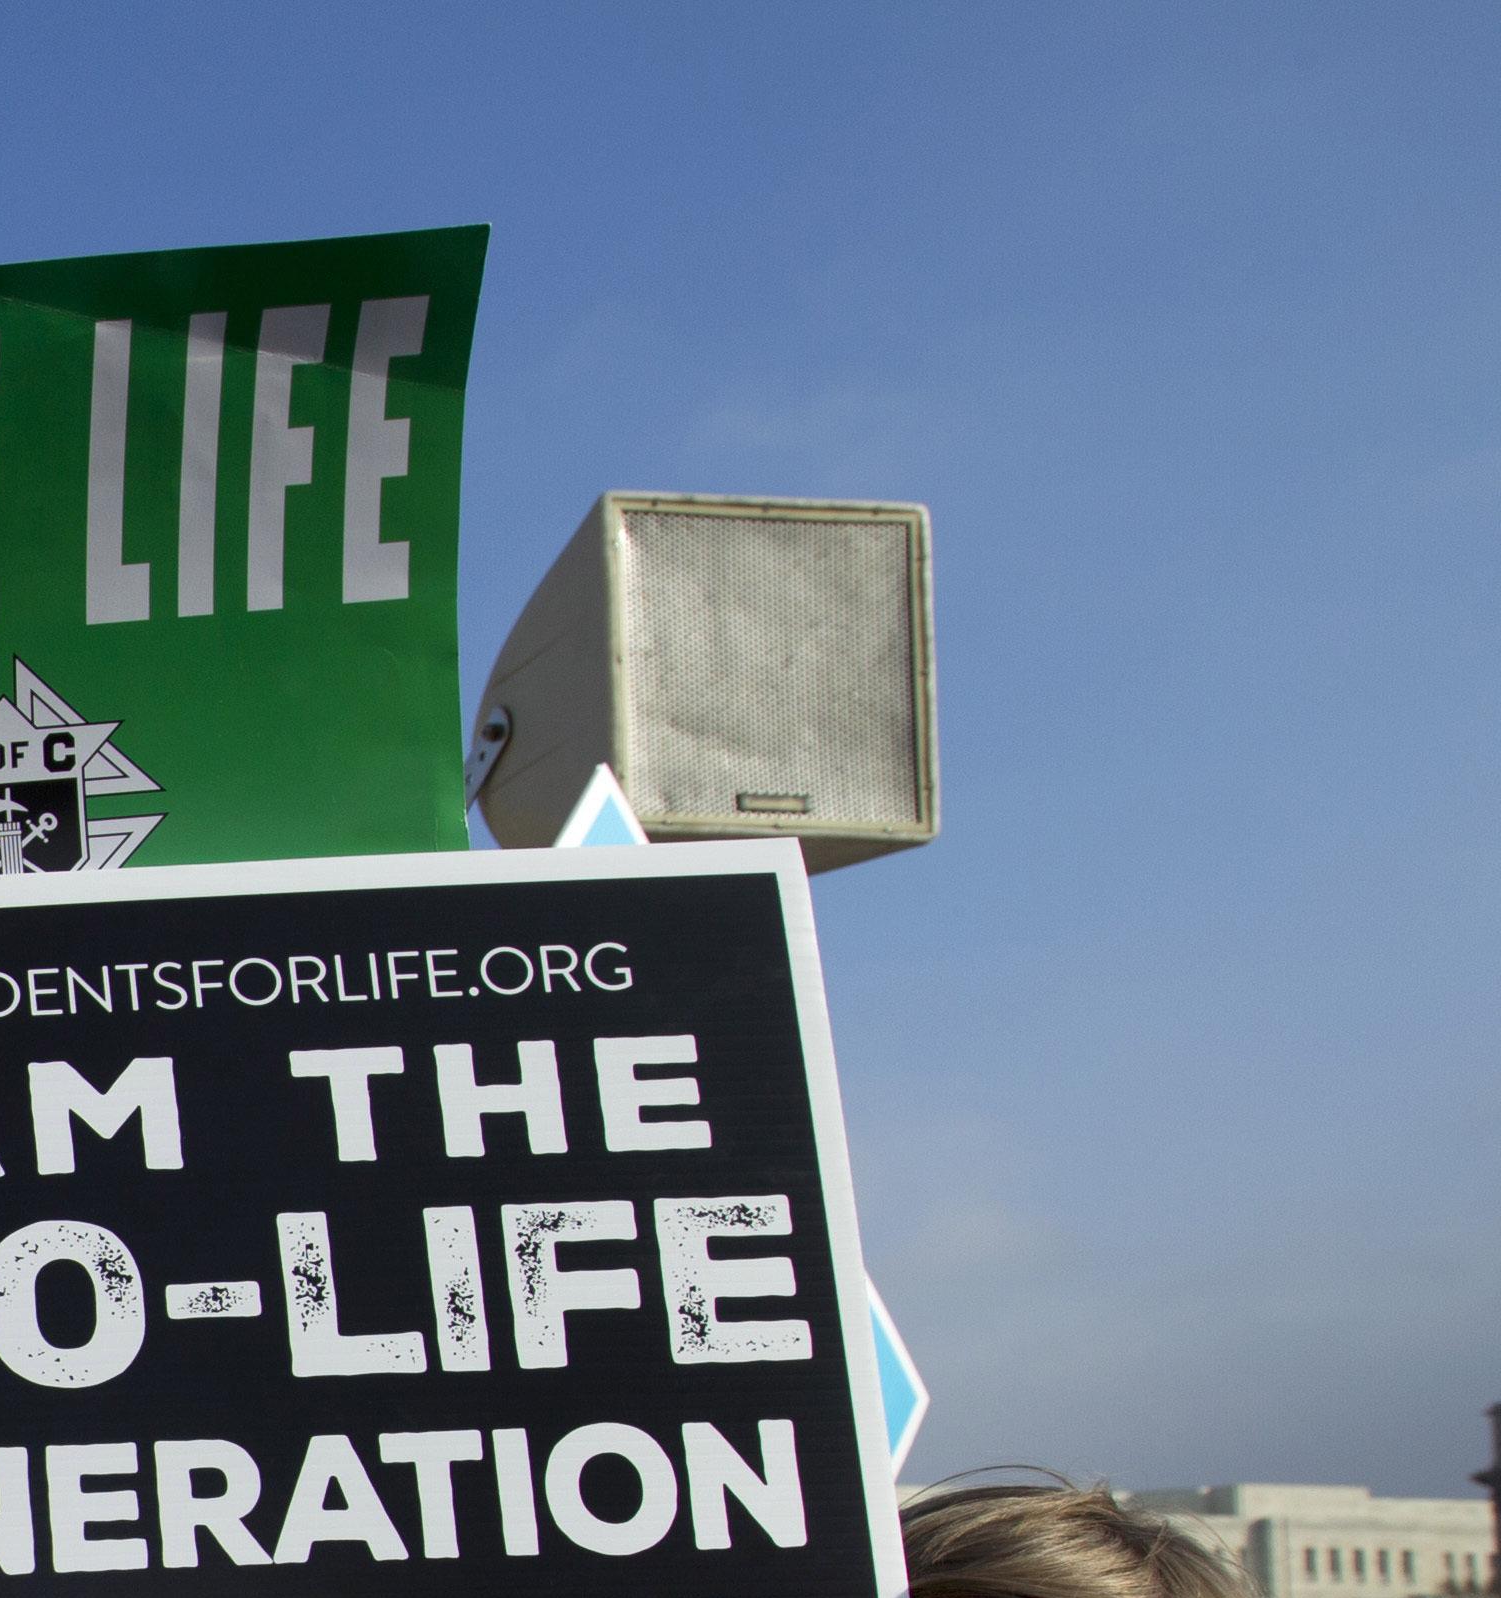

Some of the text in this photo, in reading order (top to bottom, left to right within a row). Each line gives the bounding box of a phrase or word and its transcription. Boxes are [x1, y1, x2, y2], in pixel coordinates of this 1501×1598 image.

[86, 295, 430, 626] LIFE
[43, 732, 76, 773] C
[288, 1035, 712, 1162] THE
